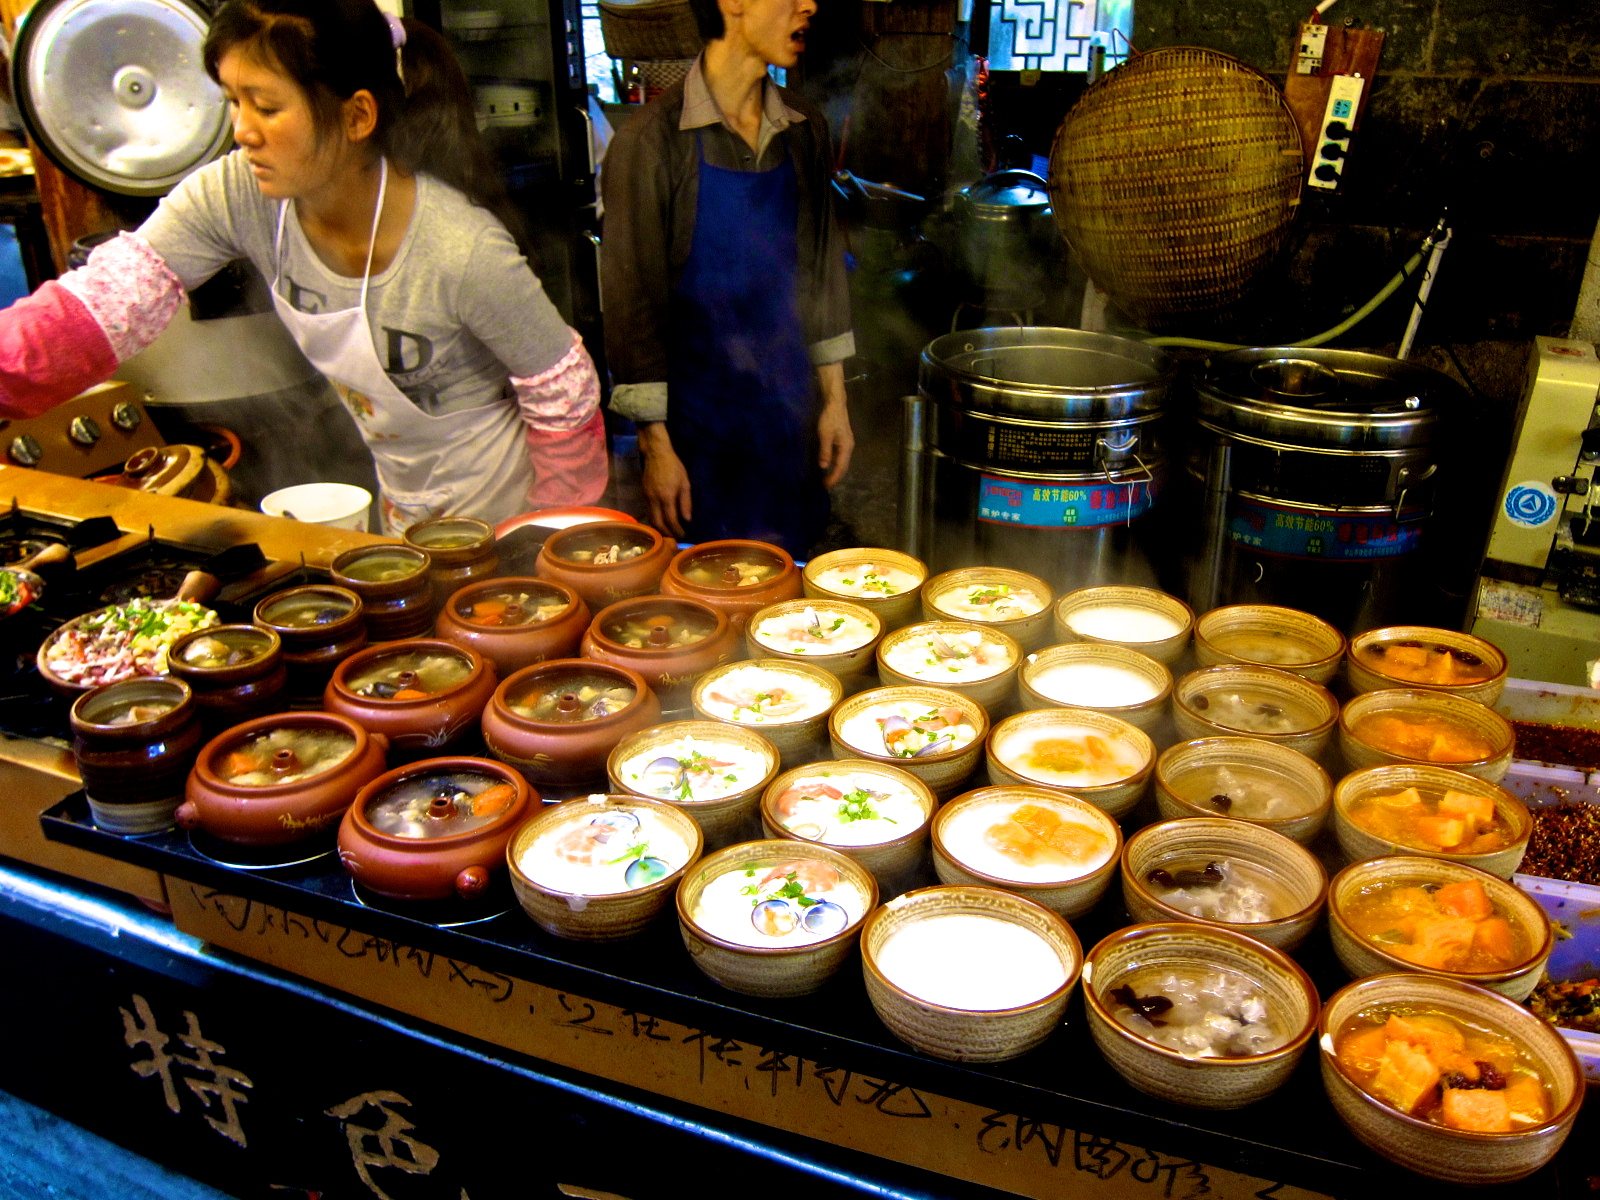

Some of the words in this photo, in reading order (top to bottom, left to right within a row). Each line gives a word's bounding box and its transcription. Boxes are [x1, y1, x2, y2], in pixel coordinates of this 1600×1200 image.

[382, 326, 433, 374] D
[1033, 487, 1087, 503] 高效节能60%
[1275, 513, 1335, 533] 高效节能60%
[119, 994, 476, 1200] 特色
